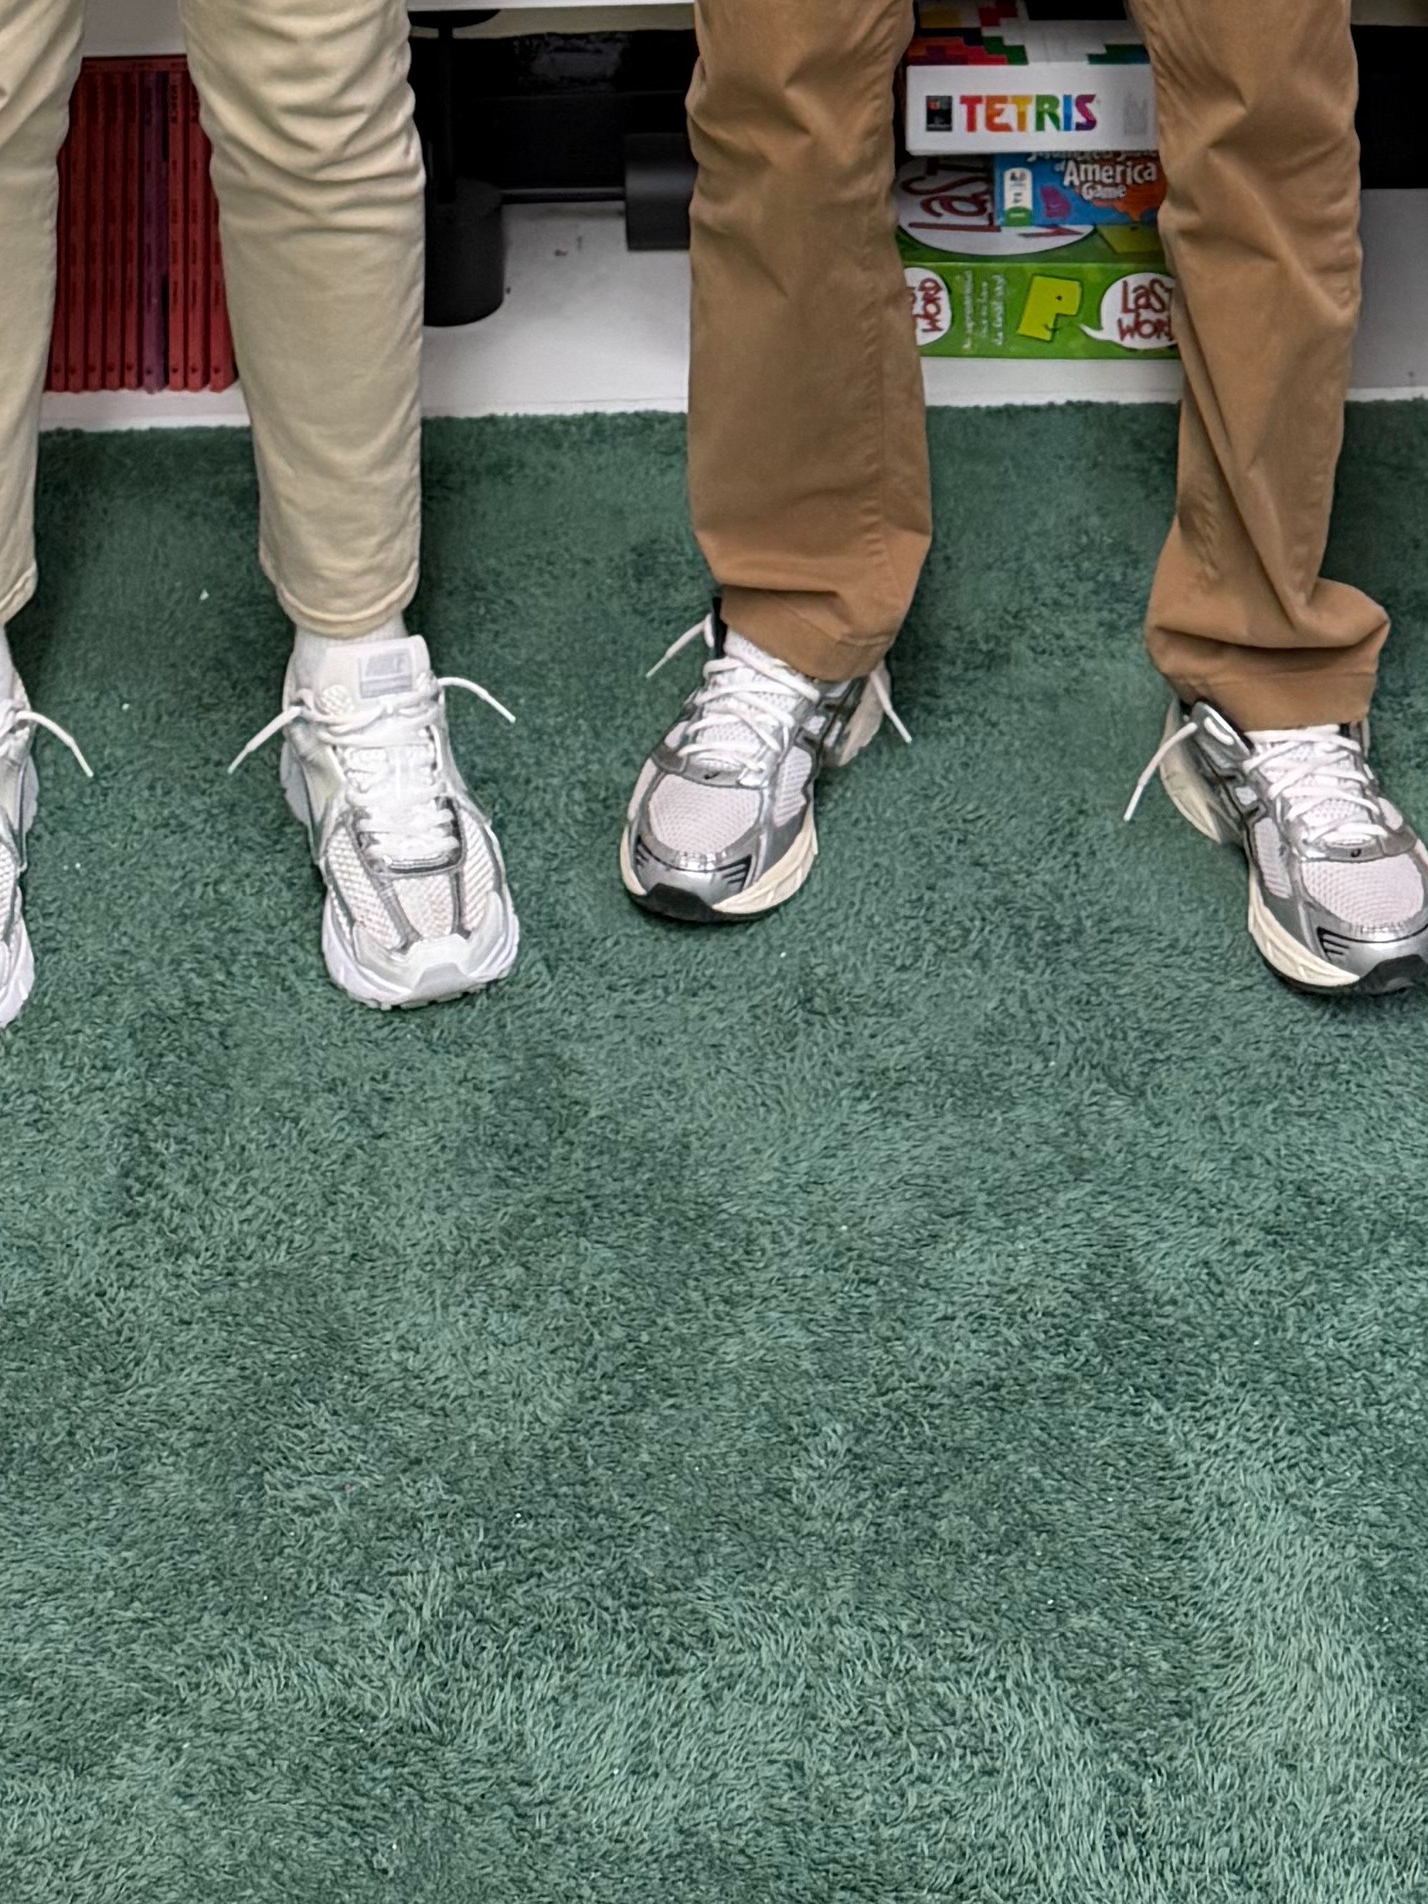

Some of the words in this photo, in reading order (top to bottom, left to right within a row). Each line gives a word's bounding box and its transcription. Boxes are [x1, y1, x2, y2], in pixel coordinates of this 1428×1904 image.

[959, 94, 1097, 133] TETRIS
[1063, 160, 1158, 186] America
[1081, 182, 1127, 200] Game
